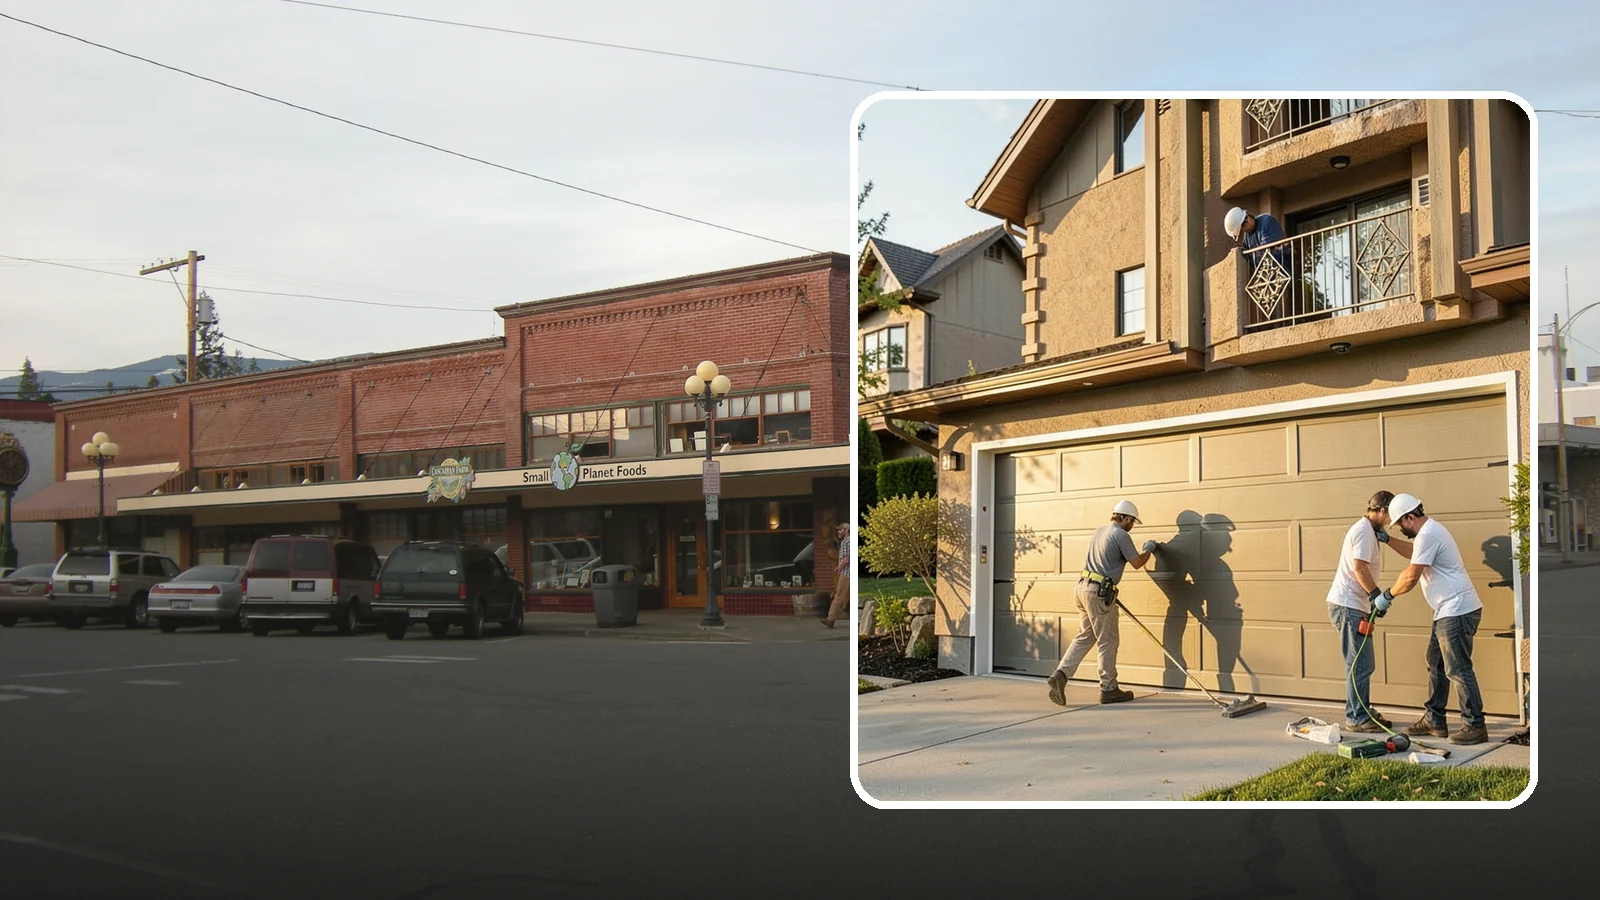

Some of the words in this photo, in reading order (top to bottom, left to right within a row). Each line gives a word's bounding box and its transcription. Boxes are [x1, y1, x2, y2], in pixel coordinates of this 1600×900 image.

[523, 471, 549, 483] Small
[583, 467, 614, 479] Planet
[617, 464, 647, 477] Foods
